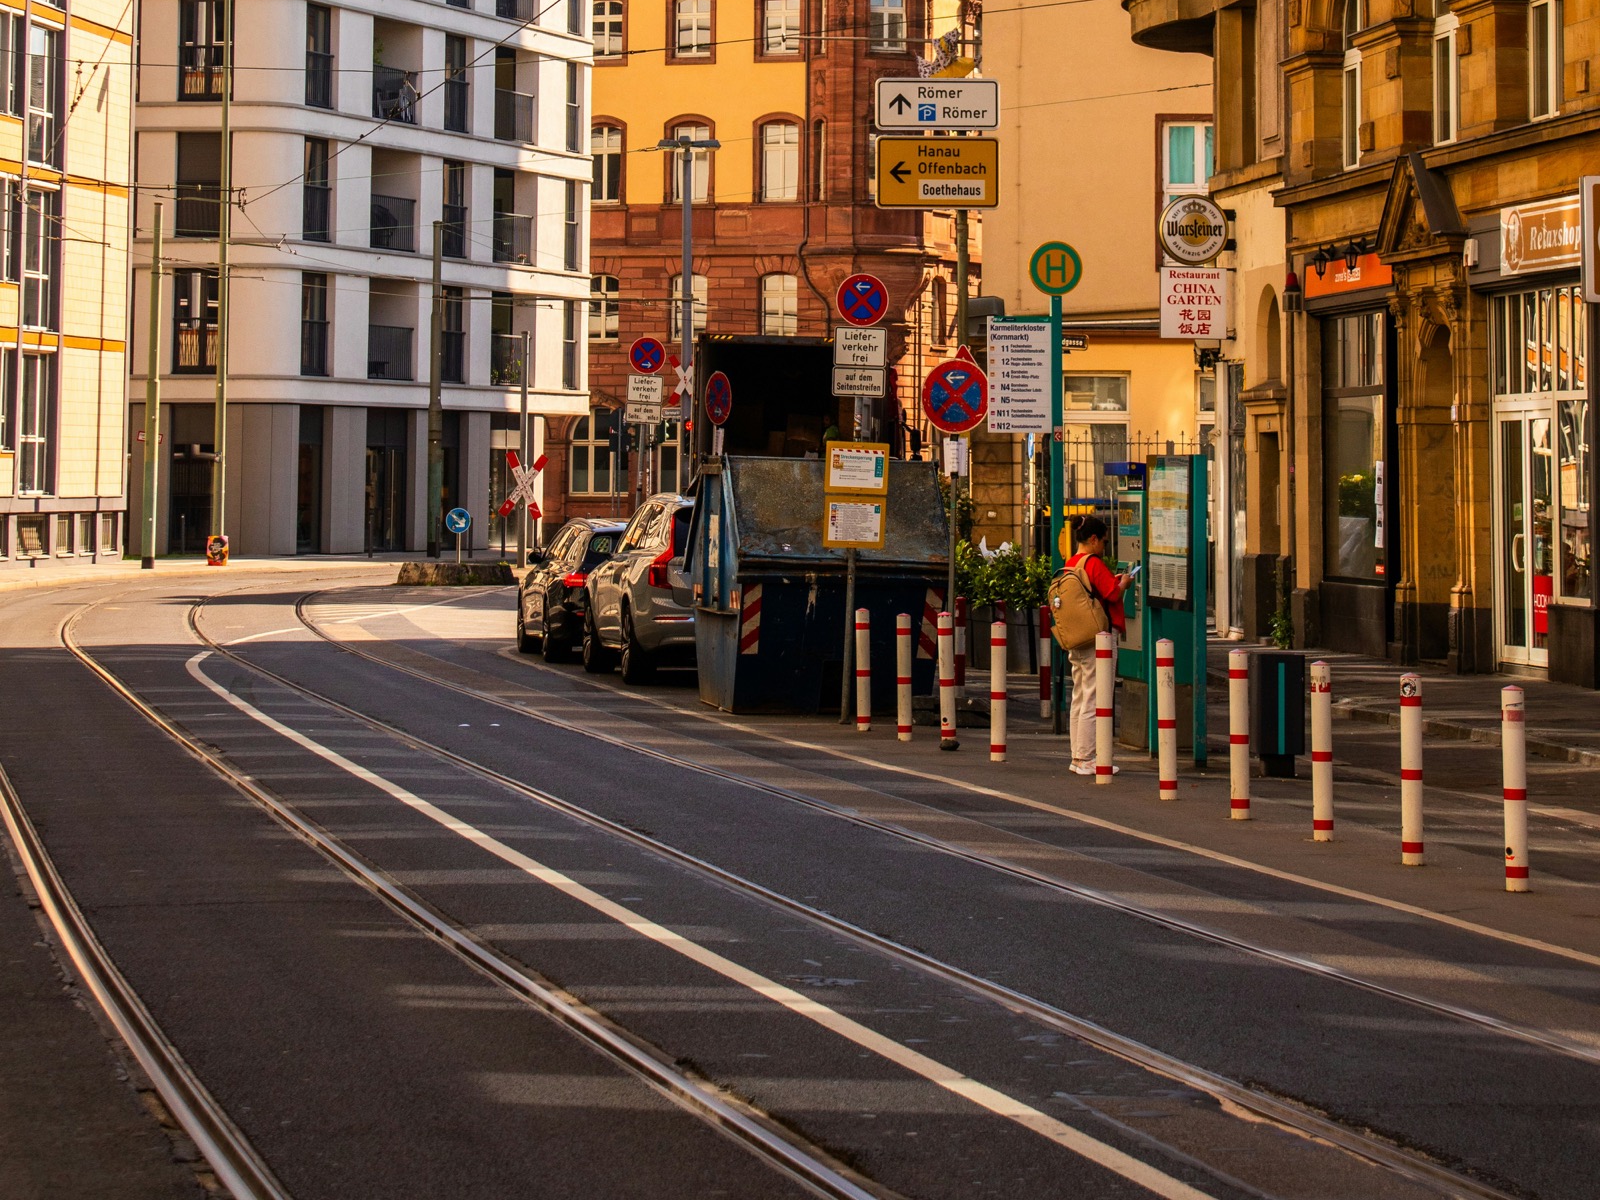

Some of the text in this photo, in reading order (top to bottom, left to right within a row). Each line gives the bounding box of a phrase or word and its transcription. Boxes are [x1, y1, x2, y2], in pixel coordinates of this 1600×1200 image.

[918, 86, 963, 99] Römer
[942, 106, 988, 118] Römer
[918, 145, 960, 157] Hanau
[918, 162, 986, 174] Offenbach
[922, 183, 981, 196] Goethehaus
[1166, 219, 1223, 239] Warsteiner
[1530, 220, 1581, 251] Relaxshop
[1173, 241, 1181, 251] DAS
[1046, 254, 1066, 283] H
[1169, 270, 1220, 280] Restaurant
[1173, 283, 1216, 294] CHINA
[1167, 294, 1222, 306] GARTEN
[1179, 308, 1211, 321] 花园
[990, 324, 1046, 332] Karmeliterkloster
[1178, 322, 1212, 335] 饭店
[844, 331, 877, 341] Liefer-
[990, 333, 1029, 341] (Kornmarkt)
[842, 342, 879, 352] verkehr
[1062, 338, 1083, 347] dgasse
[852, 353, 869, 362] frei
[634, 377, 657, 385] Liefer-
[845, 373, 873, 382] auf dem
[836, 382, 881, 392] Seitenstreifen
[1000, 383, 1010, 391] N4
[996, 422, 1011, 430] N12
